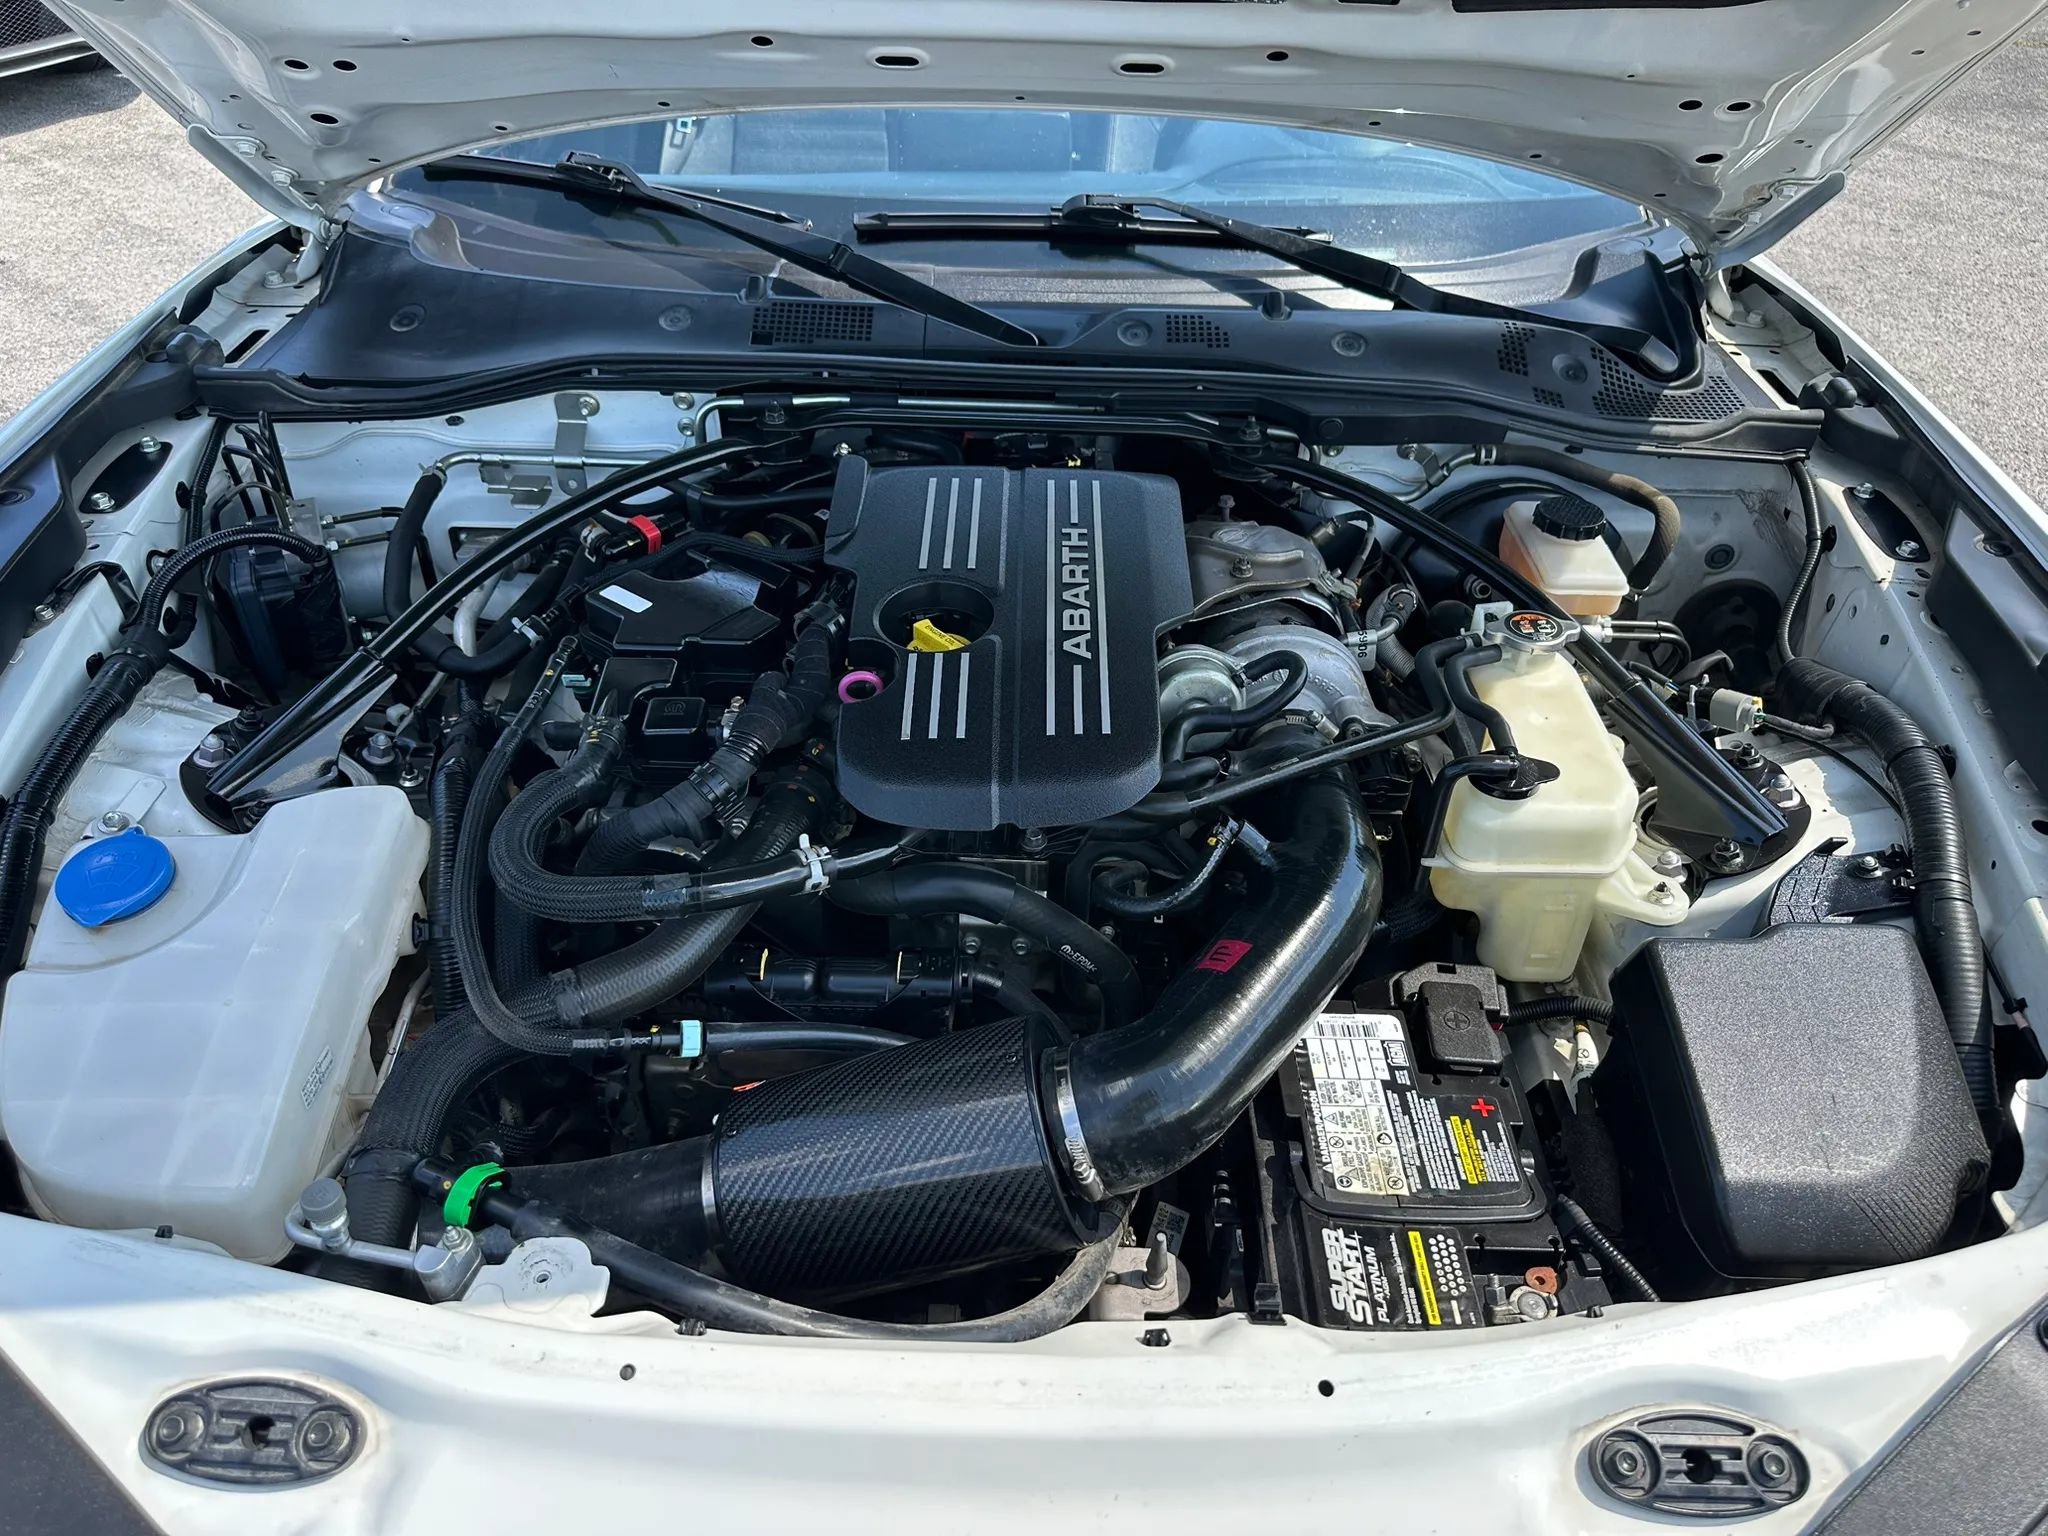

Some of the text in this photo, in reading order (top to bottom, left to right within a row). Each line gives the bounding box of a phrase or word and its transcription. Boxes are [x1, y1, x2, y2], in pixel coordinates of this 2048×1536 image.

[1061, 527, 1092, 660] ABARTH
[1321, 1227, 1346, 1311] SUPER
[1336, 1227, 1374, 1326] START
[1363, 1245, 1391, 1323] PLATINUM
